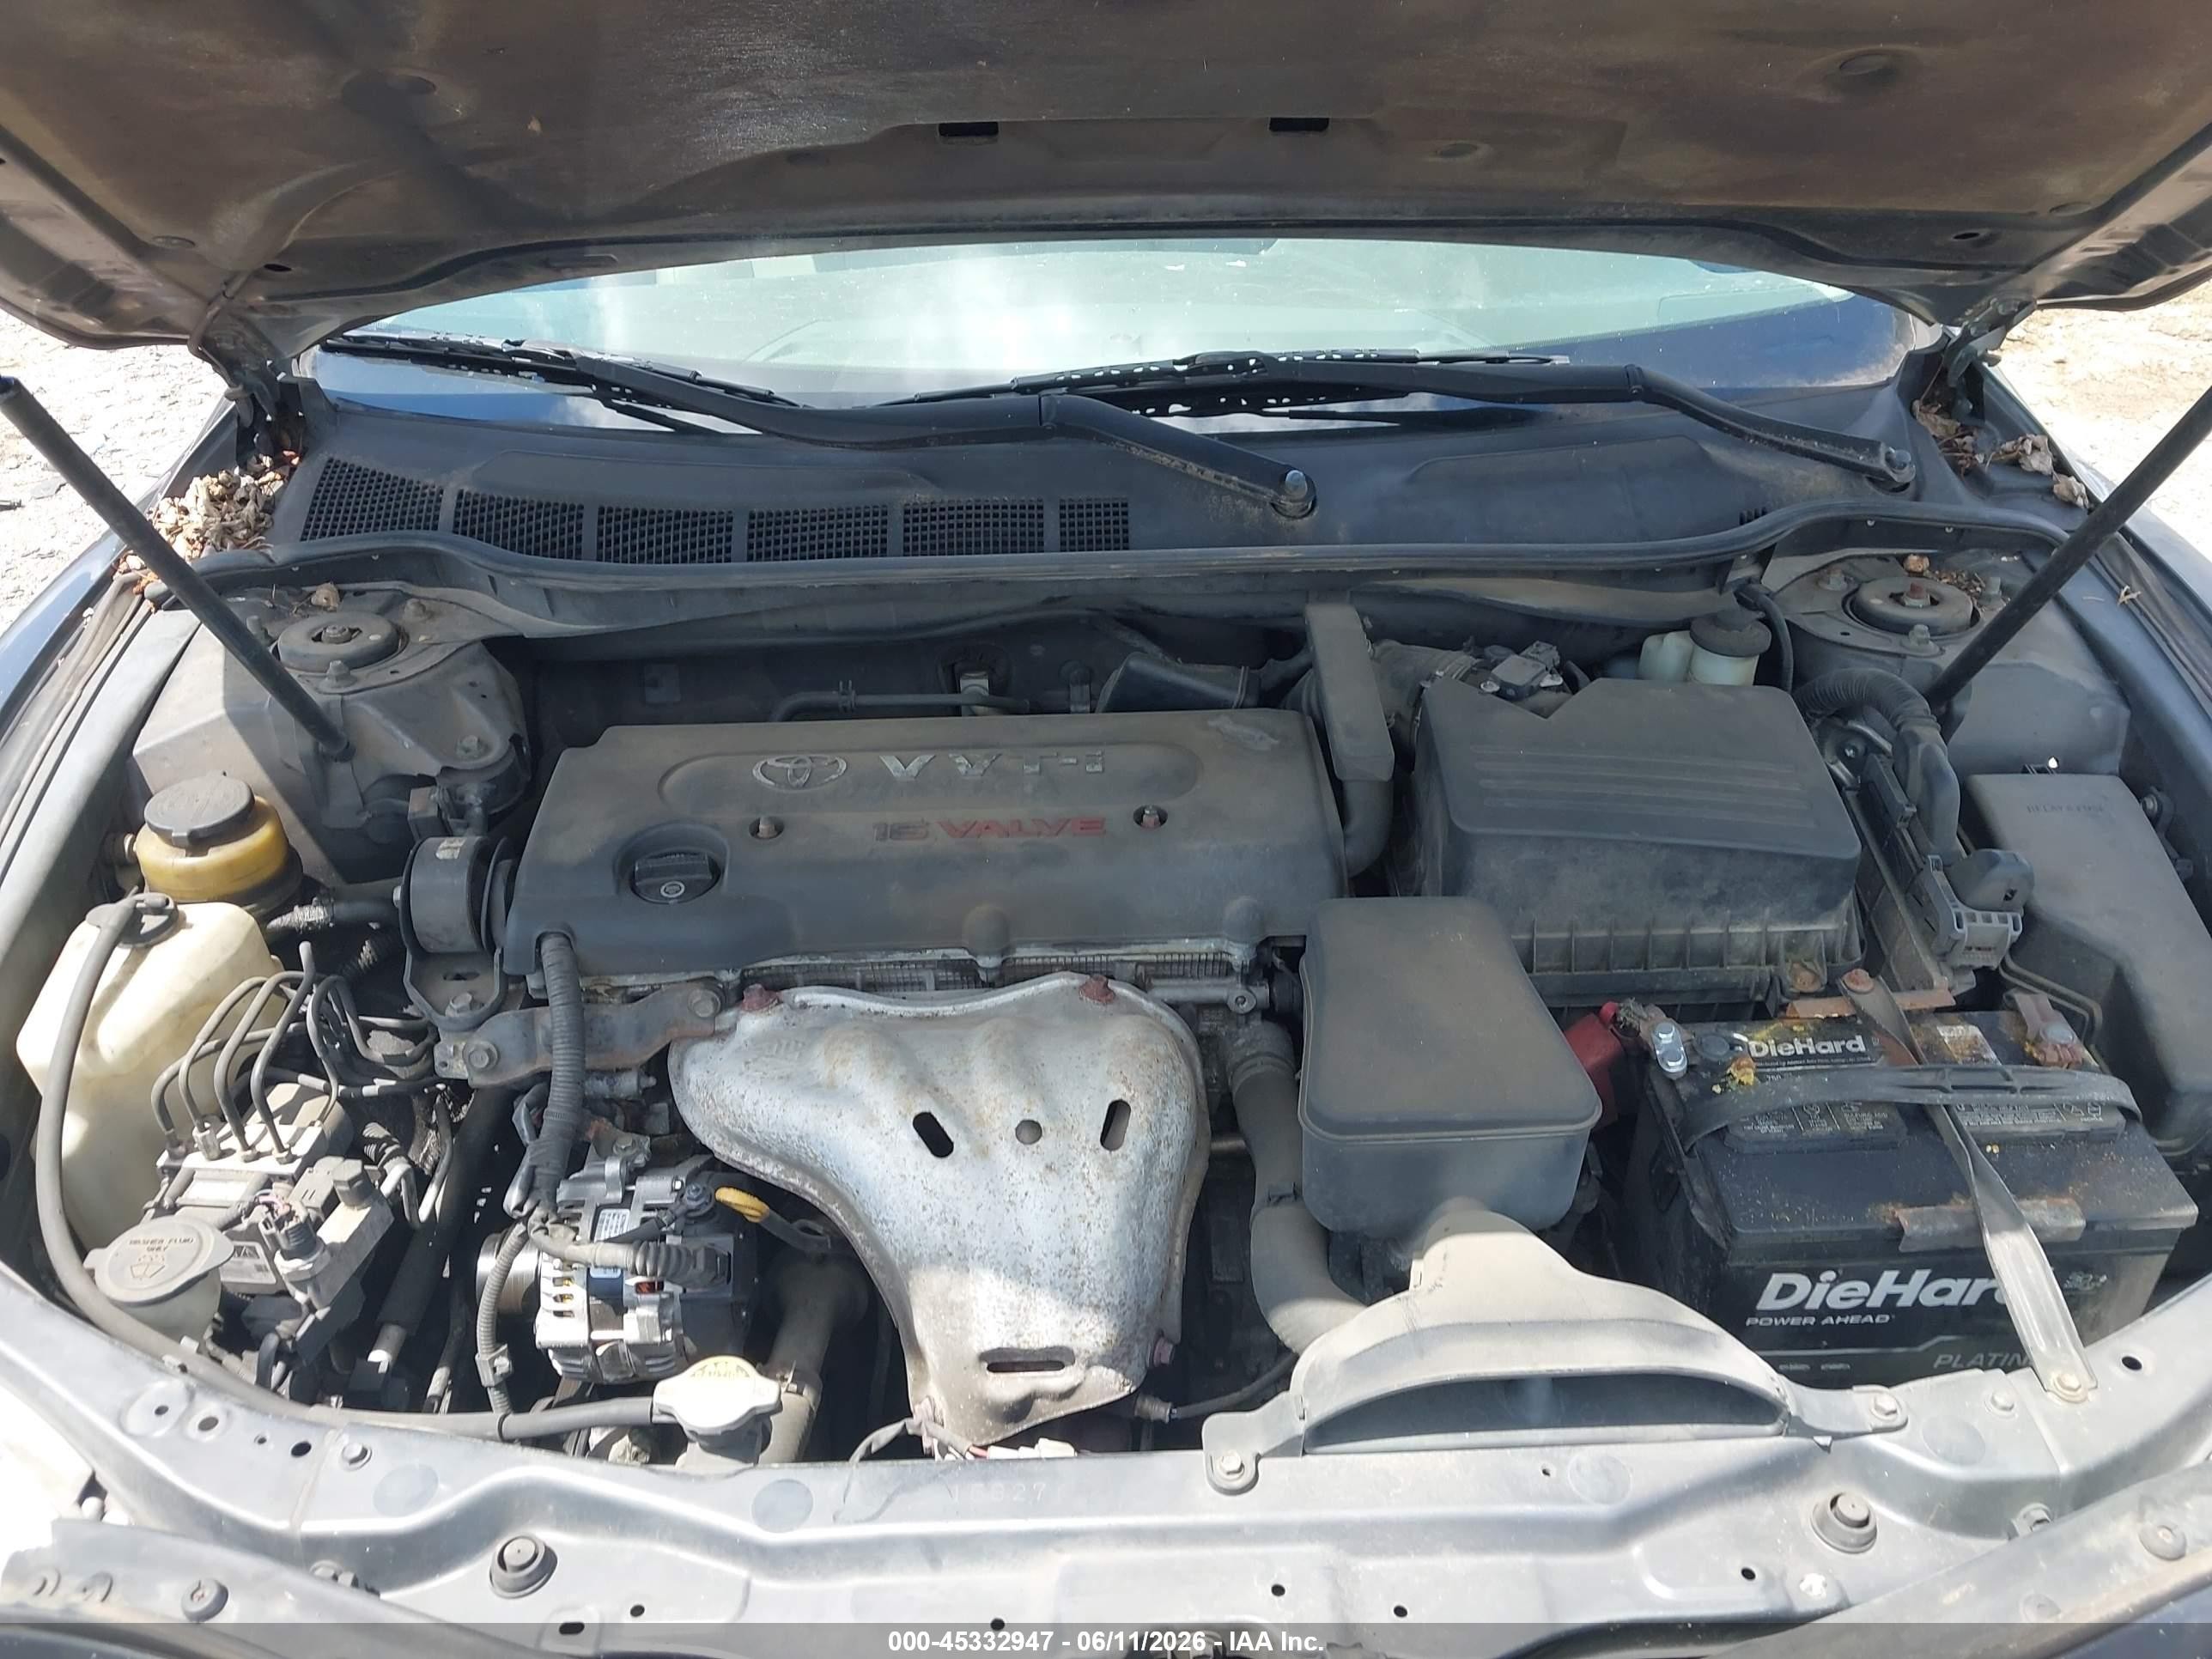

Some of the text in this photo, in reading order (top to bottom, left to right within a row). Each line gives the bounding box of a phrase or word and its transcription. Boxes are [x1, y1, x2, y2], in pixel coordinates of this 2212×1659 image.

[936, 817, 1106, 839] VALVE
[1748, 1035, 1866, 1058] DieHard
[1746, 1314, 1891, 1327] POWER AHEAD
